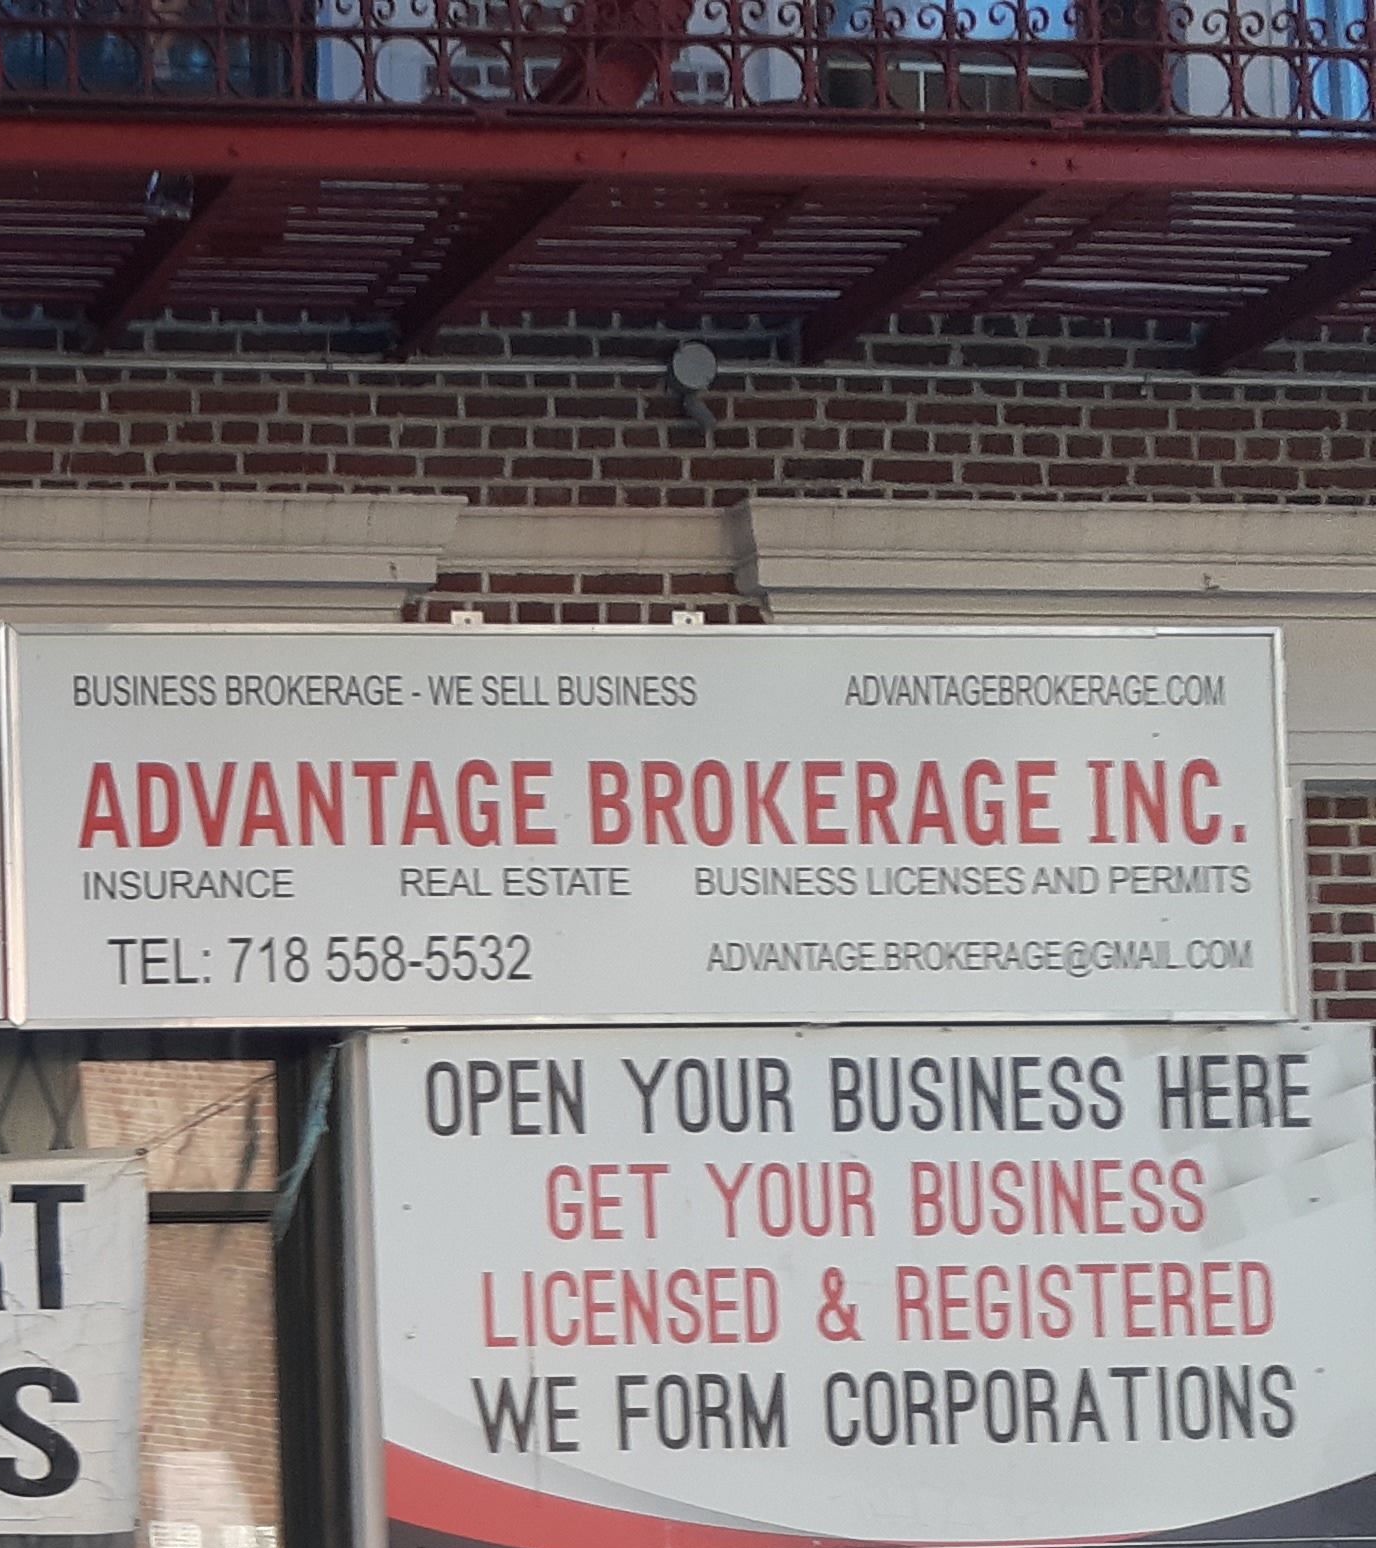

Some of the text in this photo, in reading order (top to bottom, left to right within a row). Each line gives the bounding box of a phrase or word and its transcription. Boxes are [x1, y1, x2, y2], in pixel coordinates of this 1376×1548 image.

[74, 675, 216, 706] BUSINESS
[226, 675, 403, 706] BROKERAGE
[428, 676, 473, 705] WE
[482, 676, 549, 706] SELL
[558, 676, 697, 706] BUSINESS
[845, 675, 1225, 706] ADVANTAGEBROKERAGE.COM
[80, 759, 1245, 848] ADVANTAGE BROKERAGE INC.
[84, 870, 294, 900] INSURANCE
[401, 868, 631, 896] REAL ESTATE
[696, 865, 1250, 895] BUSINESS LICENSES AND PERMITS
[108, 935, 531, 984] TEL: 718 558-5532
[707, 940, 1252, 977] ADVANTAGE.BROKERAGE@GMAIL.COM
[426, 1054, 1310, 1136] OPEN YOUR BUSINESS HERE
[547, 1159, 1205, 1240] GET YOUR BUSINESS
[483, 1262, 1273, 1347] LICENSED & REGISTERED
[473, 1365, 1294, 1453] WE FORM CORPORATIONS
